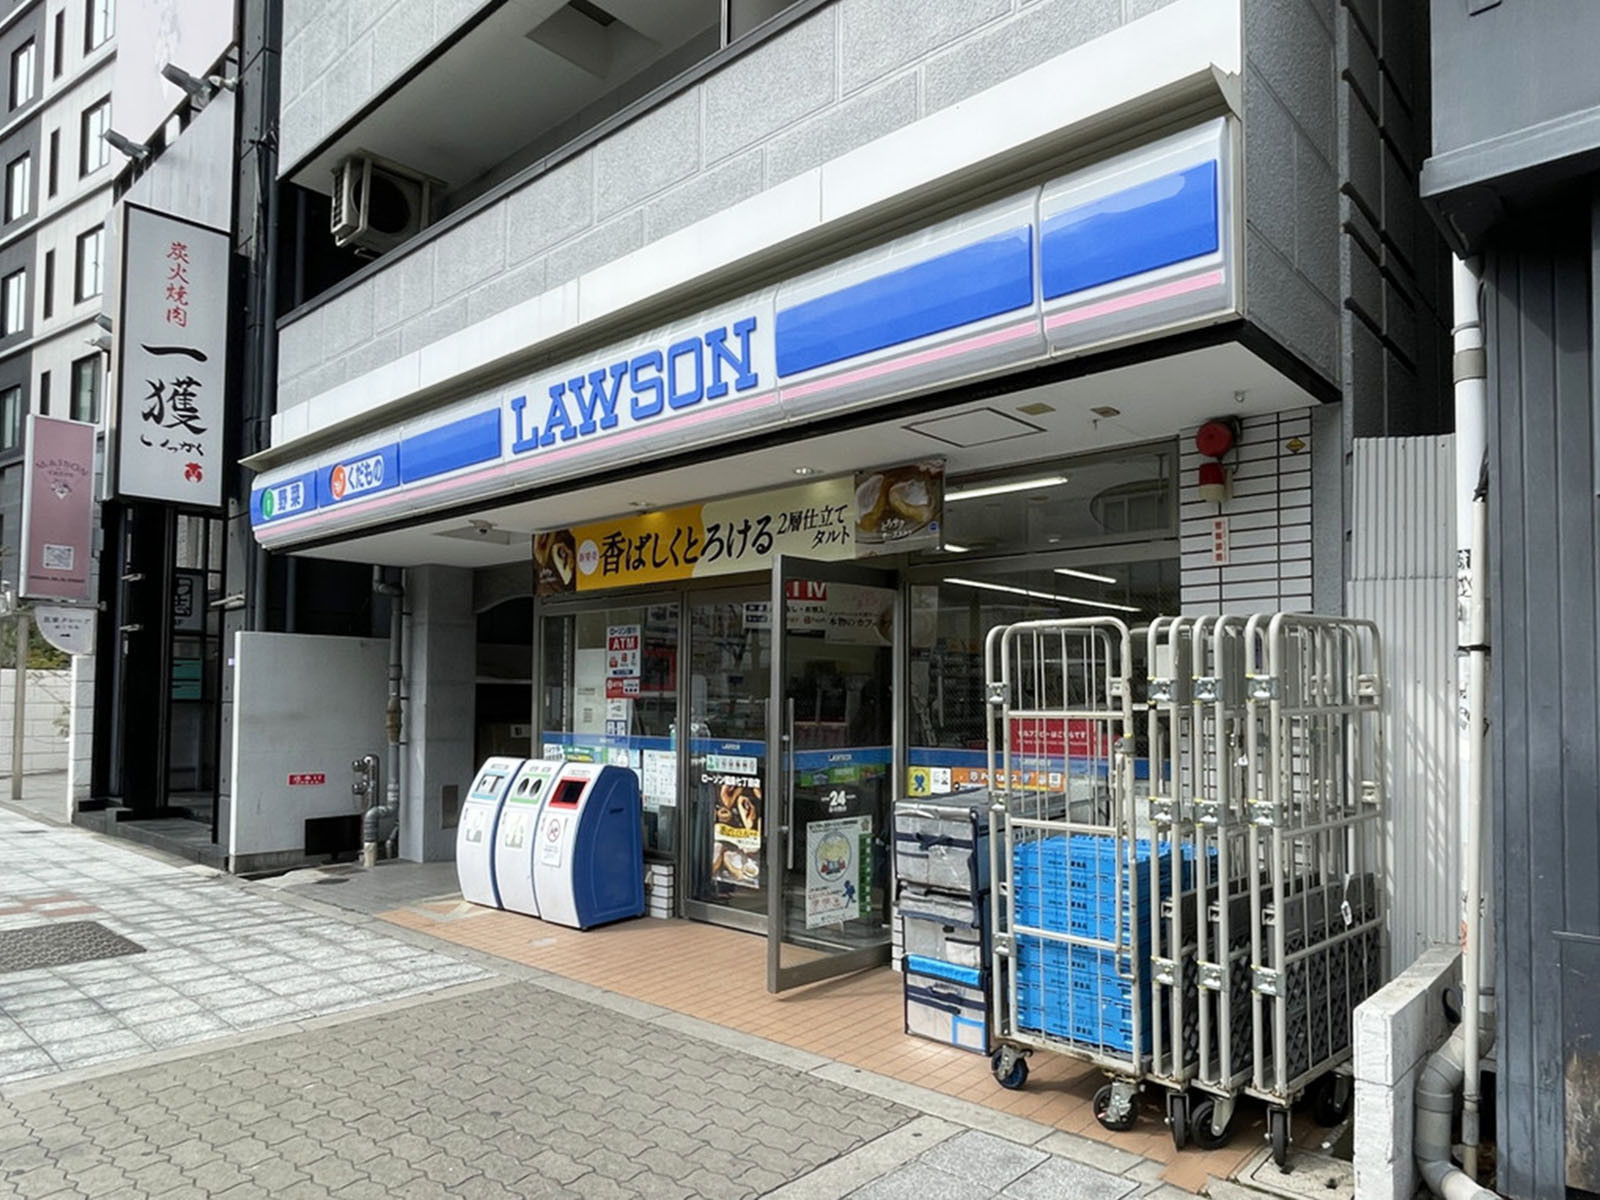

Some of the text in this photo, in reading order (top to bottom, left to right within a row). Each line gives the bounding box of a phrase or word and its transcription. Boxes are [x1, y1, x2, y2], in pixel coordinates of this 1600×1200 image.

[166, 241, 190, 328] 炭火焼肉
[140, 343, 208, 435] 一獲
[511, 316, 758, 454] LAWSON
[347, 458, 383, 490] くだもの
[277, 483, 301, 511] 野菜
[776, 504, 849, 535] 2層仕立て
[600, 514, 774, 578] 香ばしくとろける
[811, 525, 851, 550] タルト
[611, 636, 636, 651] ATM
[829, 790, 847, 806] 24
